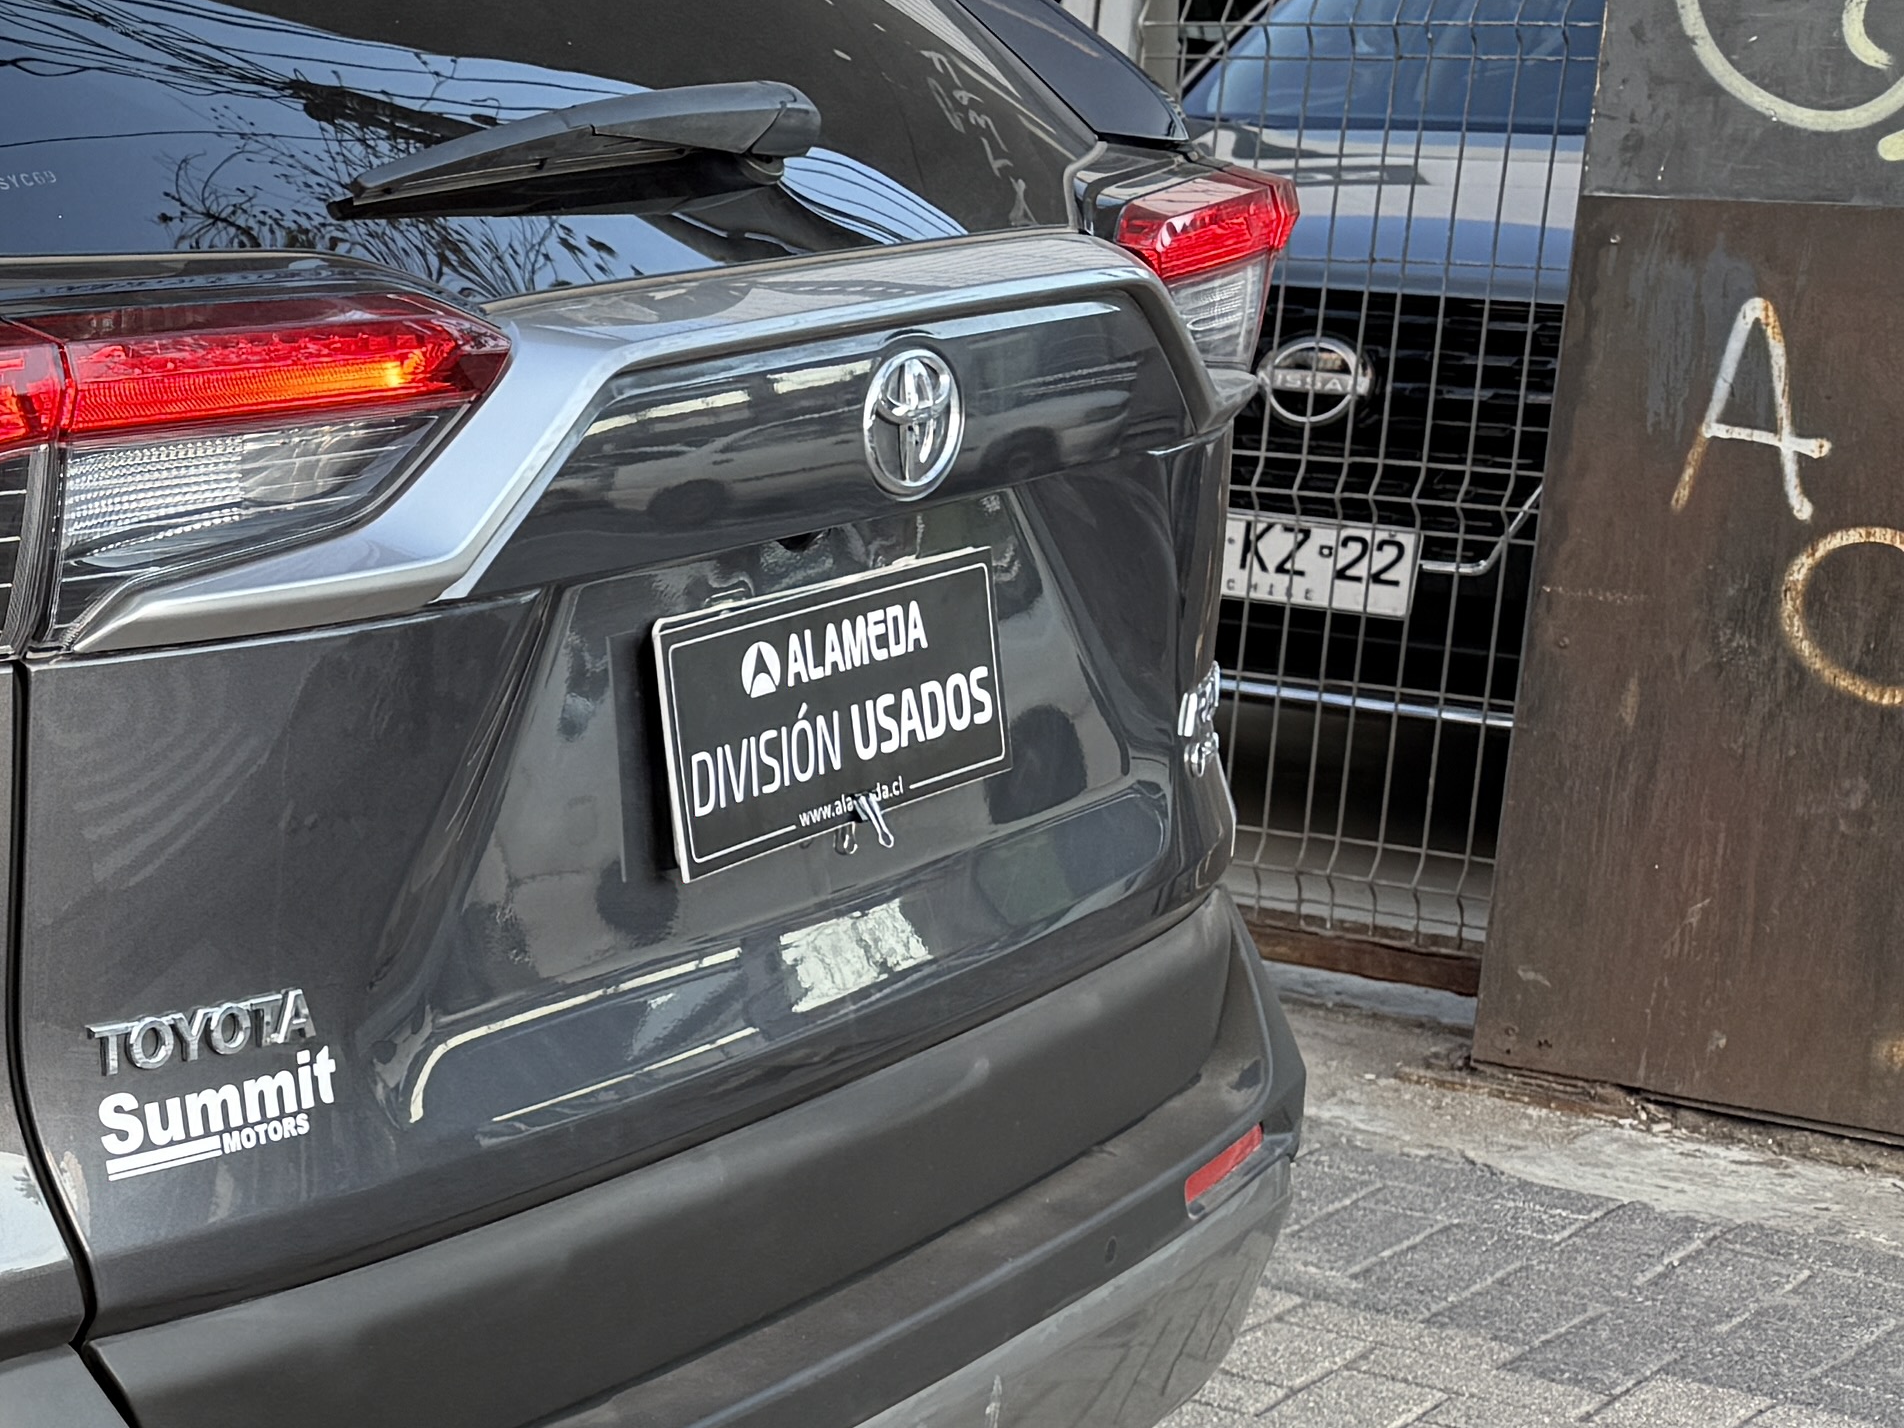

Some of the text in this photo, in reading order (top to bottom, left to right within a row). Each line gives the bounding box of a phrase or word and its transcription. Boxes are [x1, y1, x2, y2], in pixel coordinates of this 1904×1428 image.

[787, 600, 928, 687] ALAMEDA
[692, 666, 994, 818] DIVISIÓN USADOS
[798, 775, 905, 828] www.alada.cl
[85, 987, 318, 1077] TOYOTA
[97, 1044, 337, 1157] Summit
[222, 1112, 310, 1155] MOTORS
